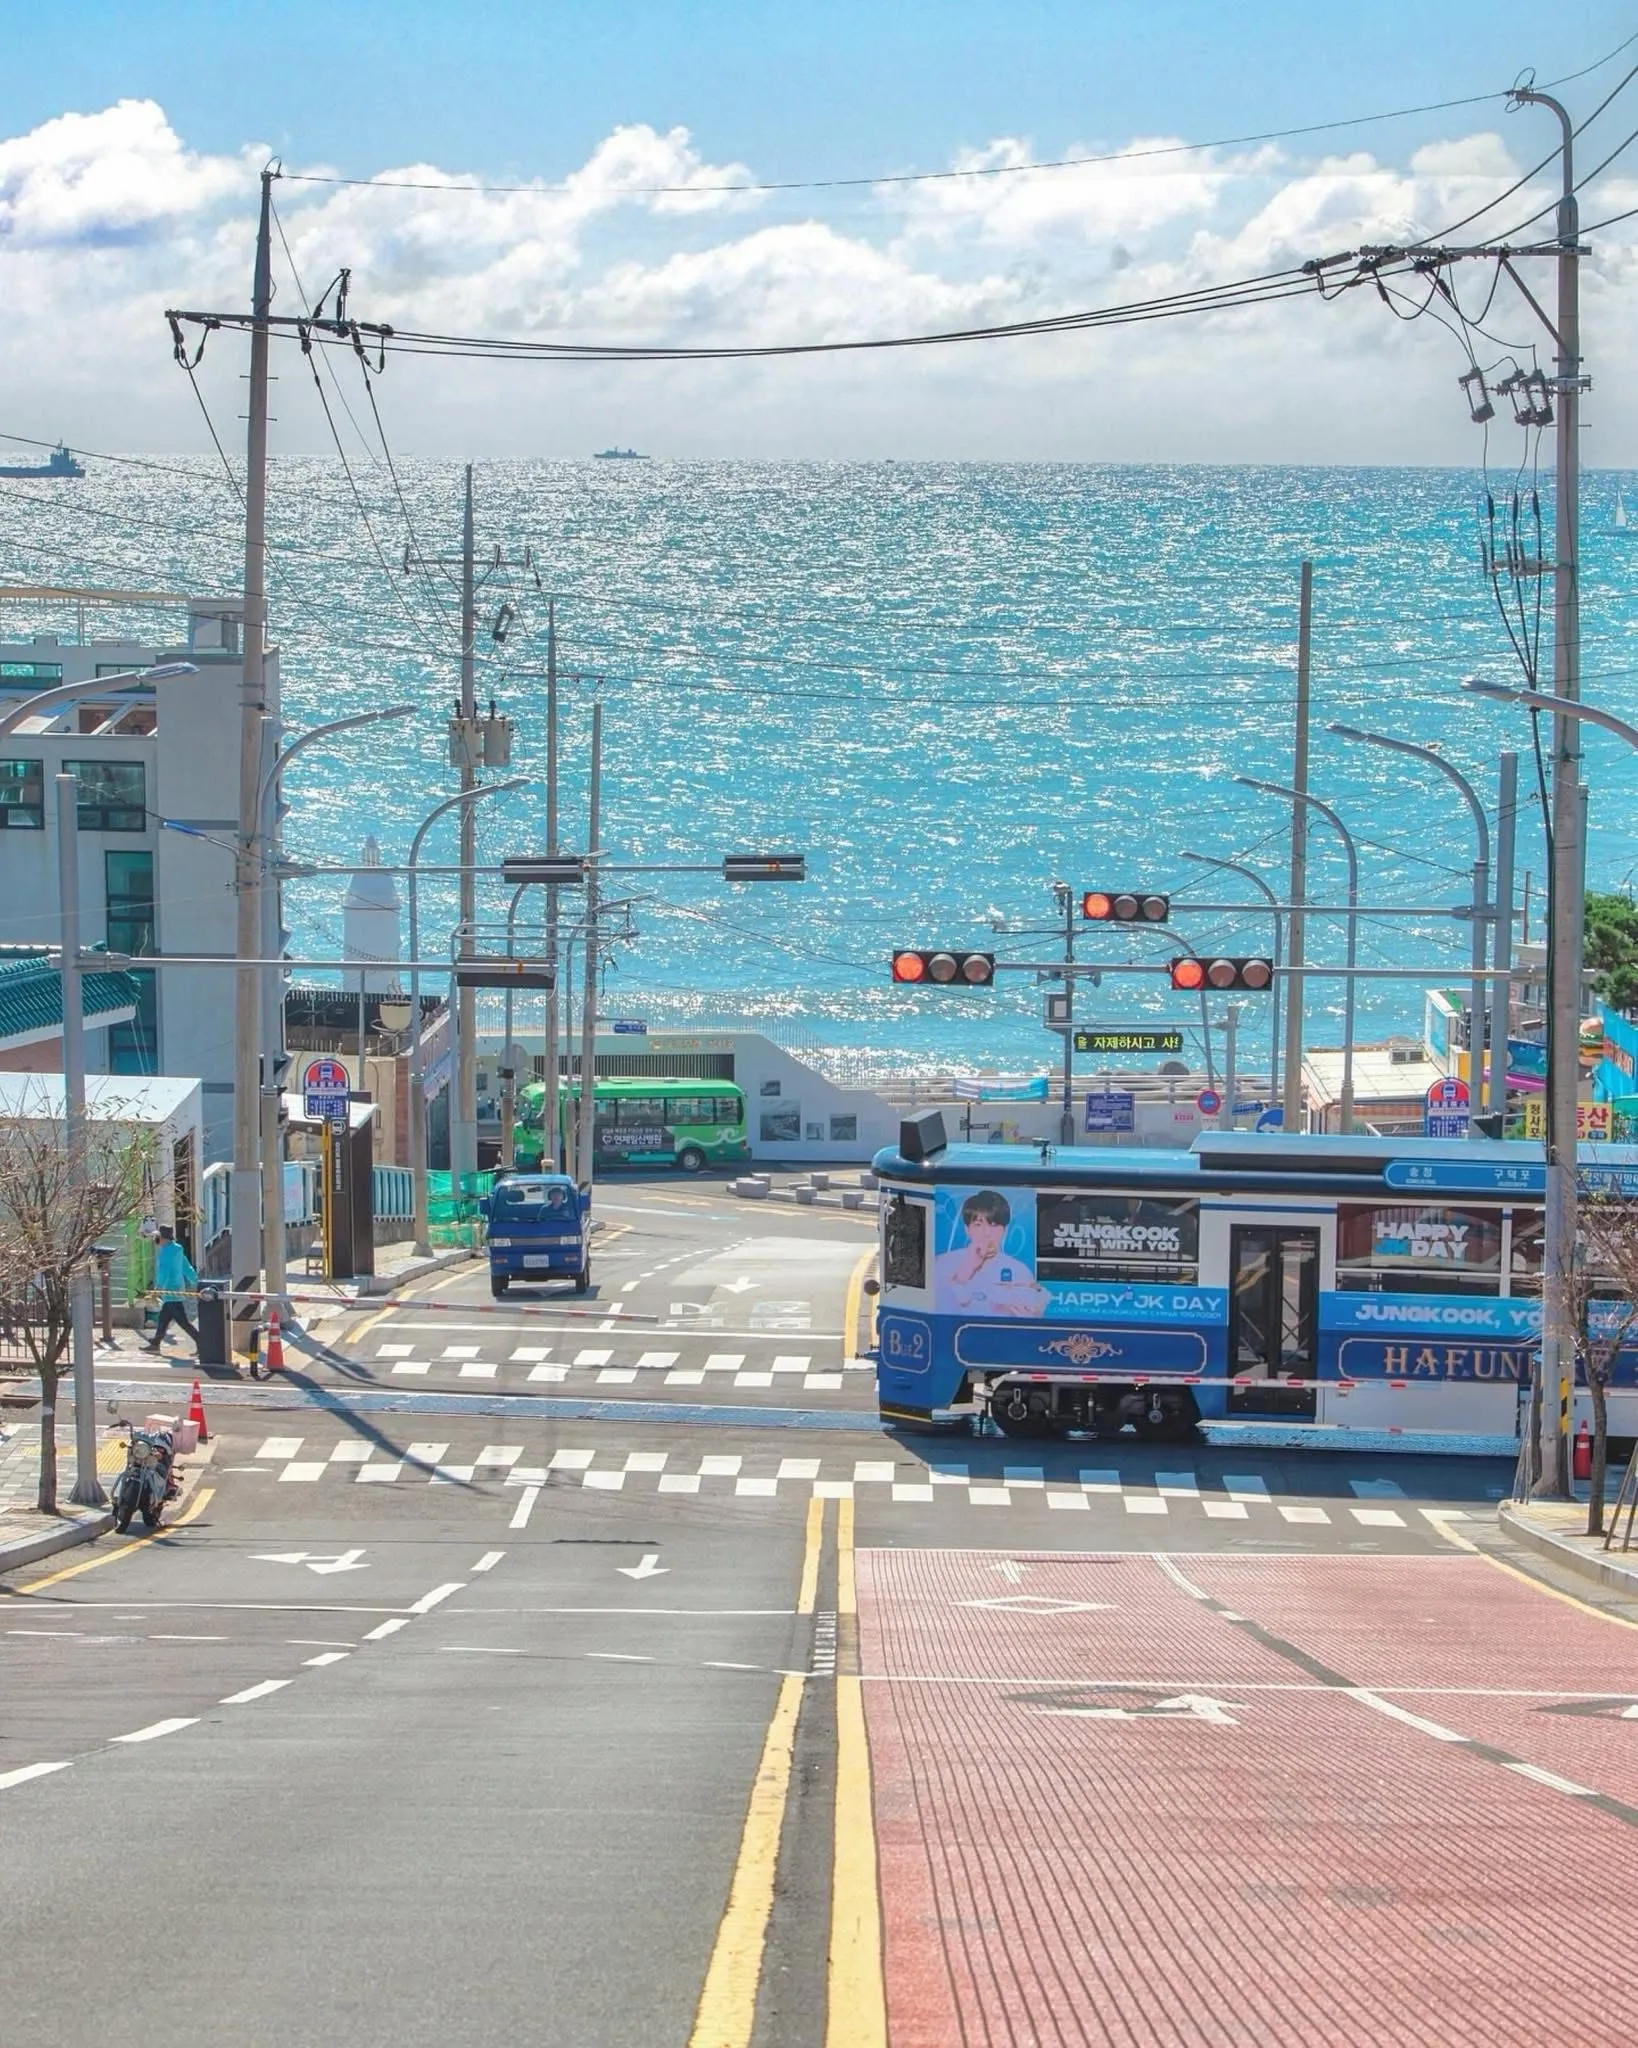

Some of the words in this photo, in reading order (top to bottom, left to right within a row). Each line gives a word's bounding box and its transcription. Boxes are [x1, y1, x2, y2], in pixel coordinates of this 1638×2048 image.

[1093, 1036, 1156, 1050] 자제하시고
[1493, 1168, 1532, 1181] 구덕포
[1053, 1223, 1180, 1241] JUNGKOOK
[1376, 1222, 1470, 1241] HAPPY
[1053, 1237, 1097, 1249] STILL
[1100, 1239, 1143, 1251] WITH
[1146, 1240, 1180, 1252] YOU
[1411, 1240, 1469, 1258] DAY
[1051, 1291, 1125, 1309] HAPPY
[1133, 1295, 1165, 1310] JK
[1172, 1296, 1222, 1311] DAY
[1355, 1304, 1501, 1329] JUNGKOOK,
[1509, 1309, 1544, 1327] YO
